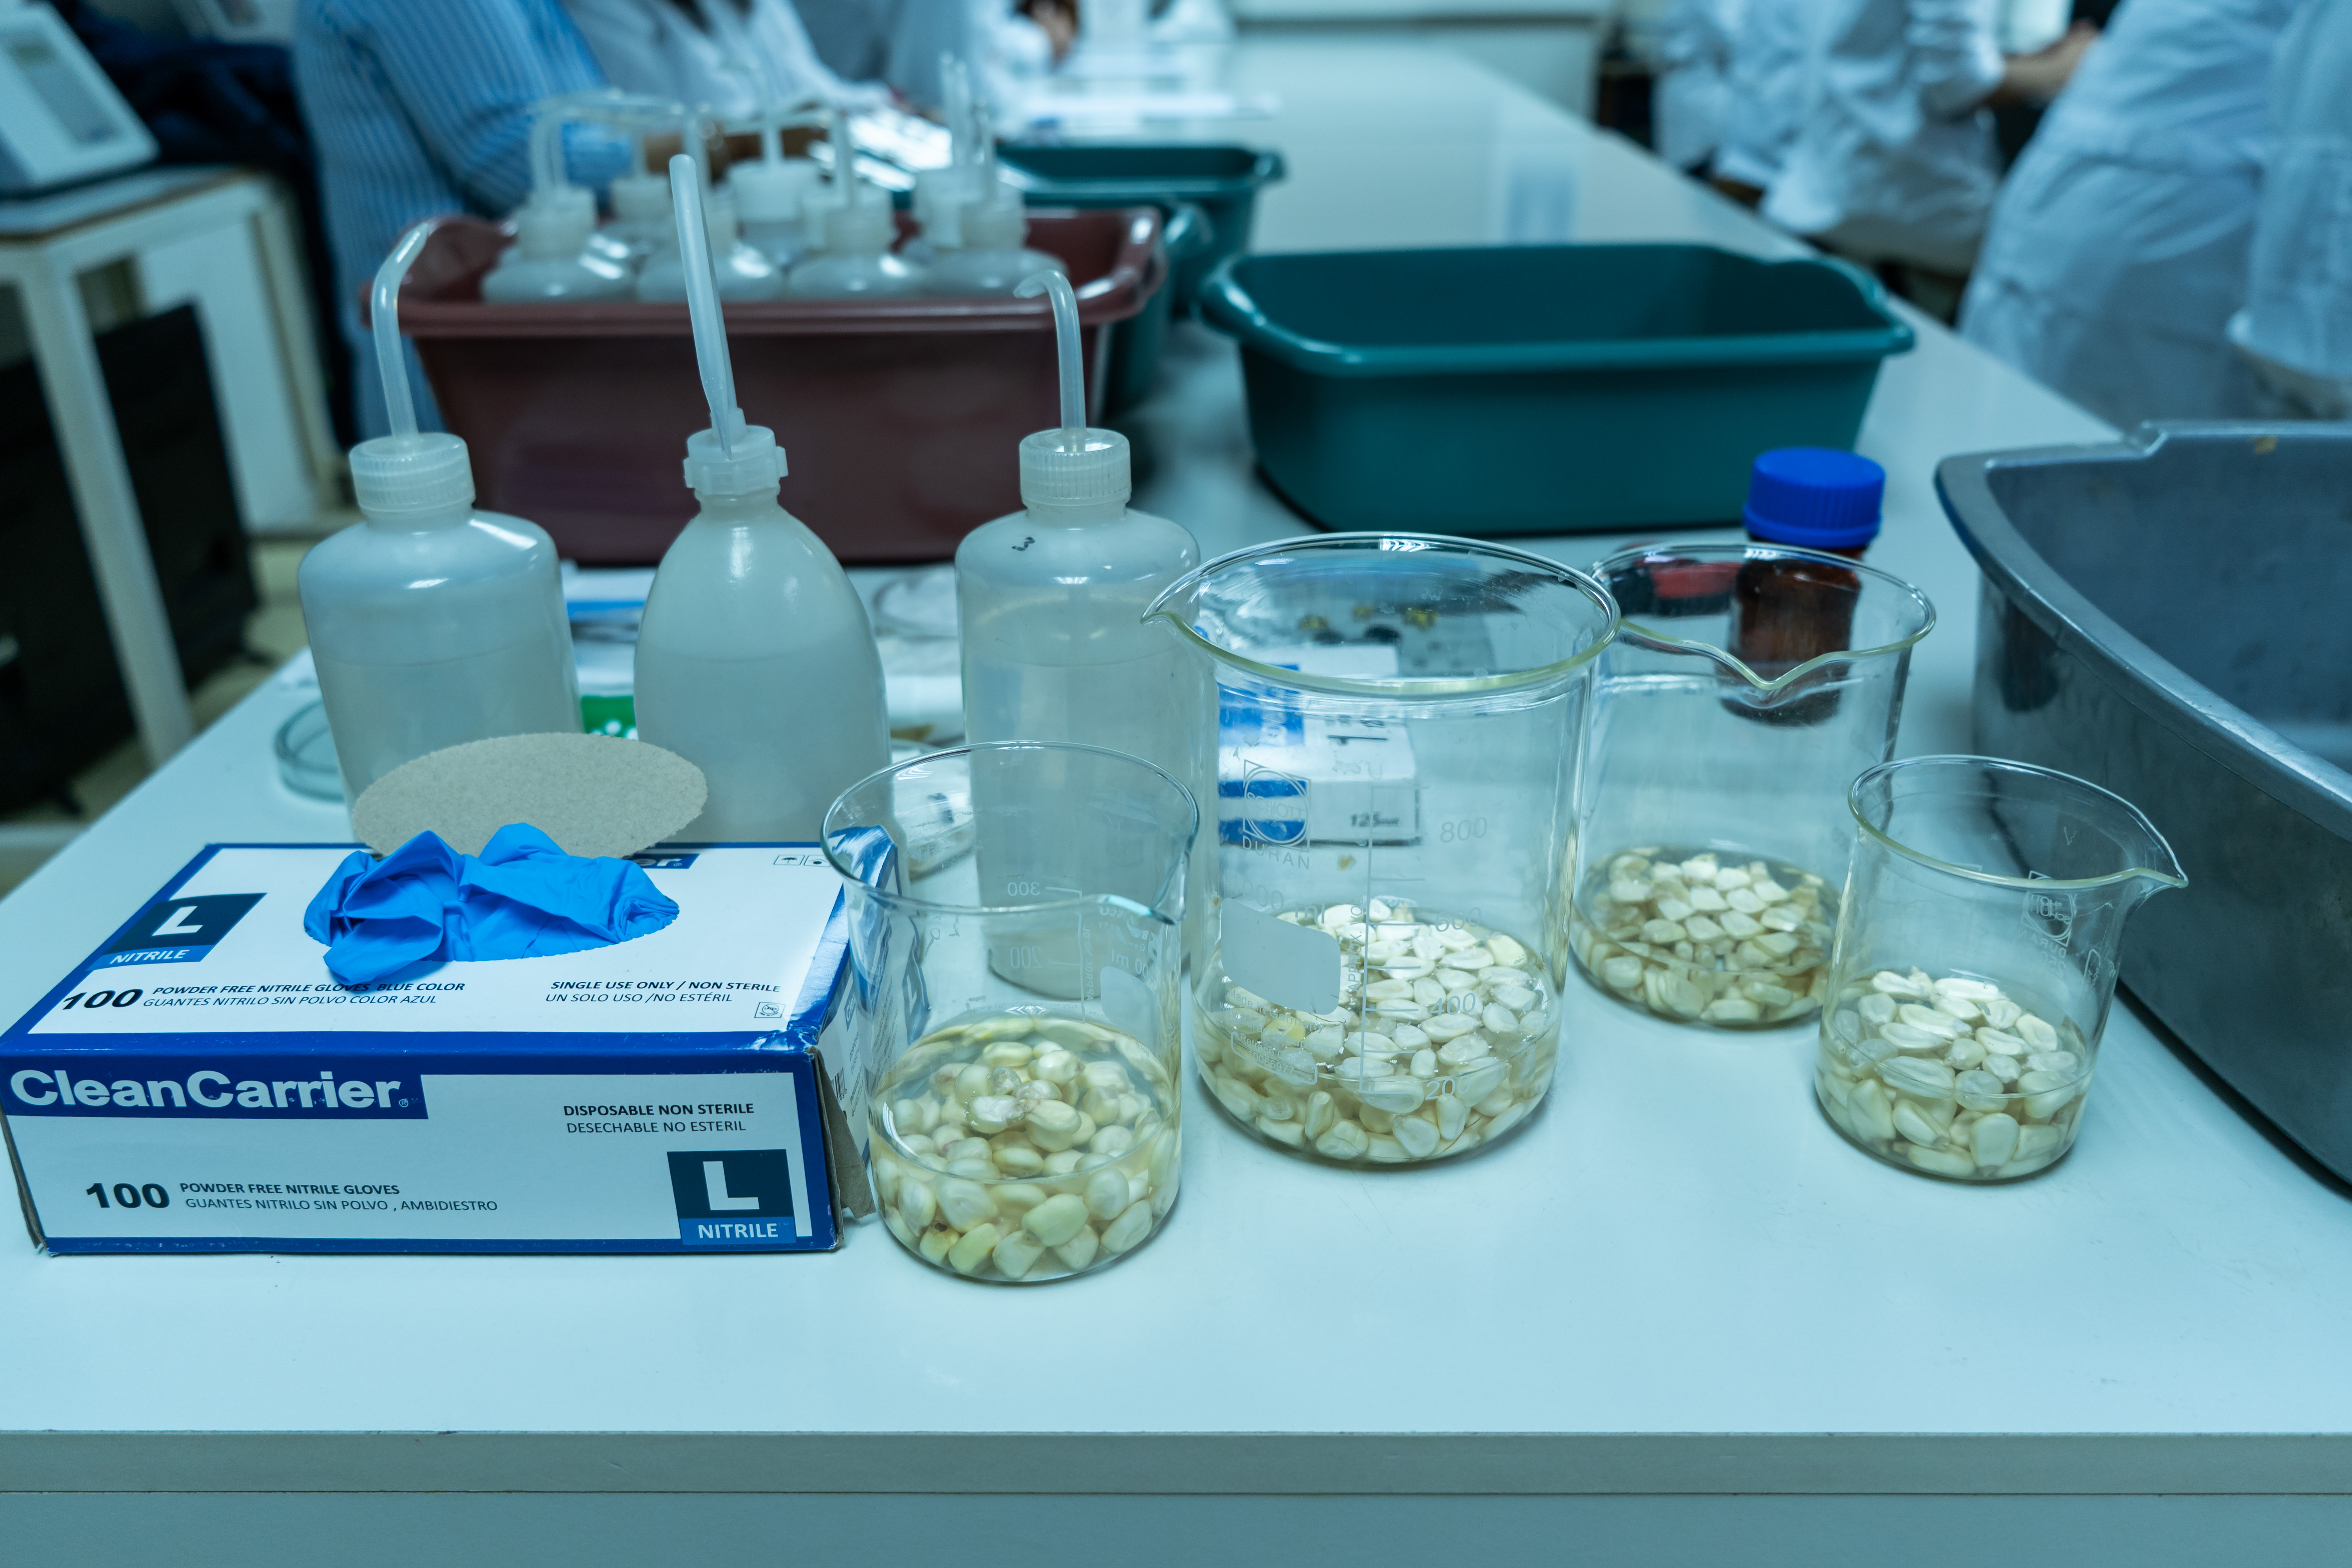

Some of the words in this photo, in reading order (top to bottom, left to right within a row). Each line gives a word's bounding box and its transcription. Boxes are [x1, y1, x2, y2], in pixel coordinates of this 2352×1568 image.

[1440, 817, 1488, 843] 800
[1242, 835, 1309, 870] DURAN
[152, 906, 203, 936] L
[1294, 902, 1326, 924] ml
[1435, 907, 1482, 932] 600
[109, 949, 190, 965] NITRILE
[62, 989, 143, 1010] 100
[152, 986, 219, 995] POWDER
[257, 984, 312, 993] NITRILE
[550, 981, 603, 989] SINGLE
[726, 982, 781, 993] STERILE
[570, 994, 609, 1002] SOLO
[613, 994, 643, 1002] USO
[645, 993, 676, 1003] /NO
[680, 992, 733, 1002] ESTÉRIL
[143, 998, 211, 1007] GUANTES
[212, 997, 270, 1006] NITRILO
[271, 996, 297, 1004] SIN
[299, 996, 347, 1004] POLVO
[350, 995, 398, 1004] COLOR
[400, 995, 437, 1004] AZUL
[1229, 987, 1253, 1007] Made
[1256, 1003, 1265, 1014] in
[1269, 1009, 1324, 1034] Germany
[1430, 993, 1476, 1016] 400
[1240, 1033, 1274, 1055] Retrace
[10, 1070, 401, 1109] CleanCarrier
[1425, 1074, 1471, 1100] 200
[563, 1105, 655, 1116] DISPOSABLE
[659, 1104, 693, 1115] NON
[698, 1103, 755, 1114] STERILE
[567, 1122, 659, 1133] DESECHABLE
[663, 1122, 686, 1132] NO
[691, 1120, 746, 1131] ESTERIL
[85, 1182, 170, 1208] 100
[180, 1183, 246, 1193] POWDER
[249, 1184, 283, 1194] FREE
[286, 1184, 341, 1194] NITRILE
[343, 1184, 400, 1195] GLOVES
[703, 1161, 760, 1210] L
[185, 1198, 252, 1209] GUANTES
[256, 1199, 310, 1210] NITRILO
[314, 1200, 338, 1210] SIN
[342, 1200, 388, 1210] POLVO
[401, 1200, 498, 1211] AMBIDIESTRO
[698, 1223, 779, 1238] NITRILE
